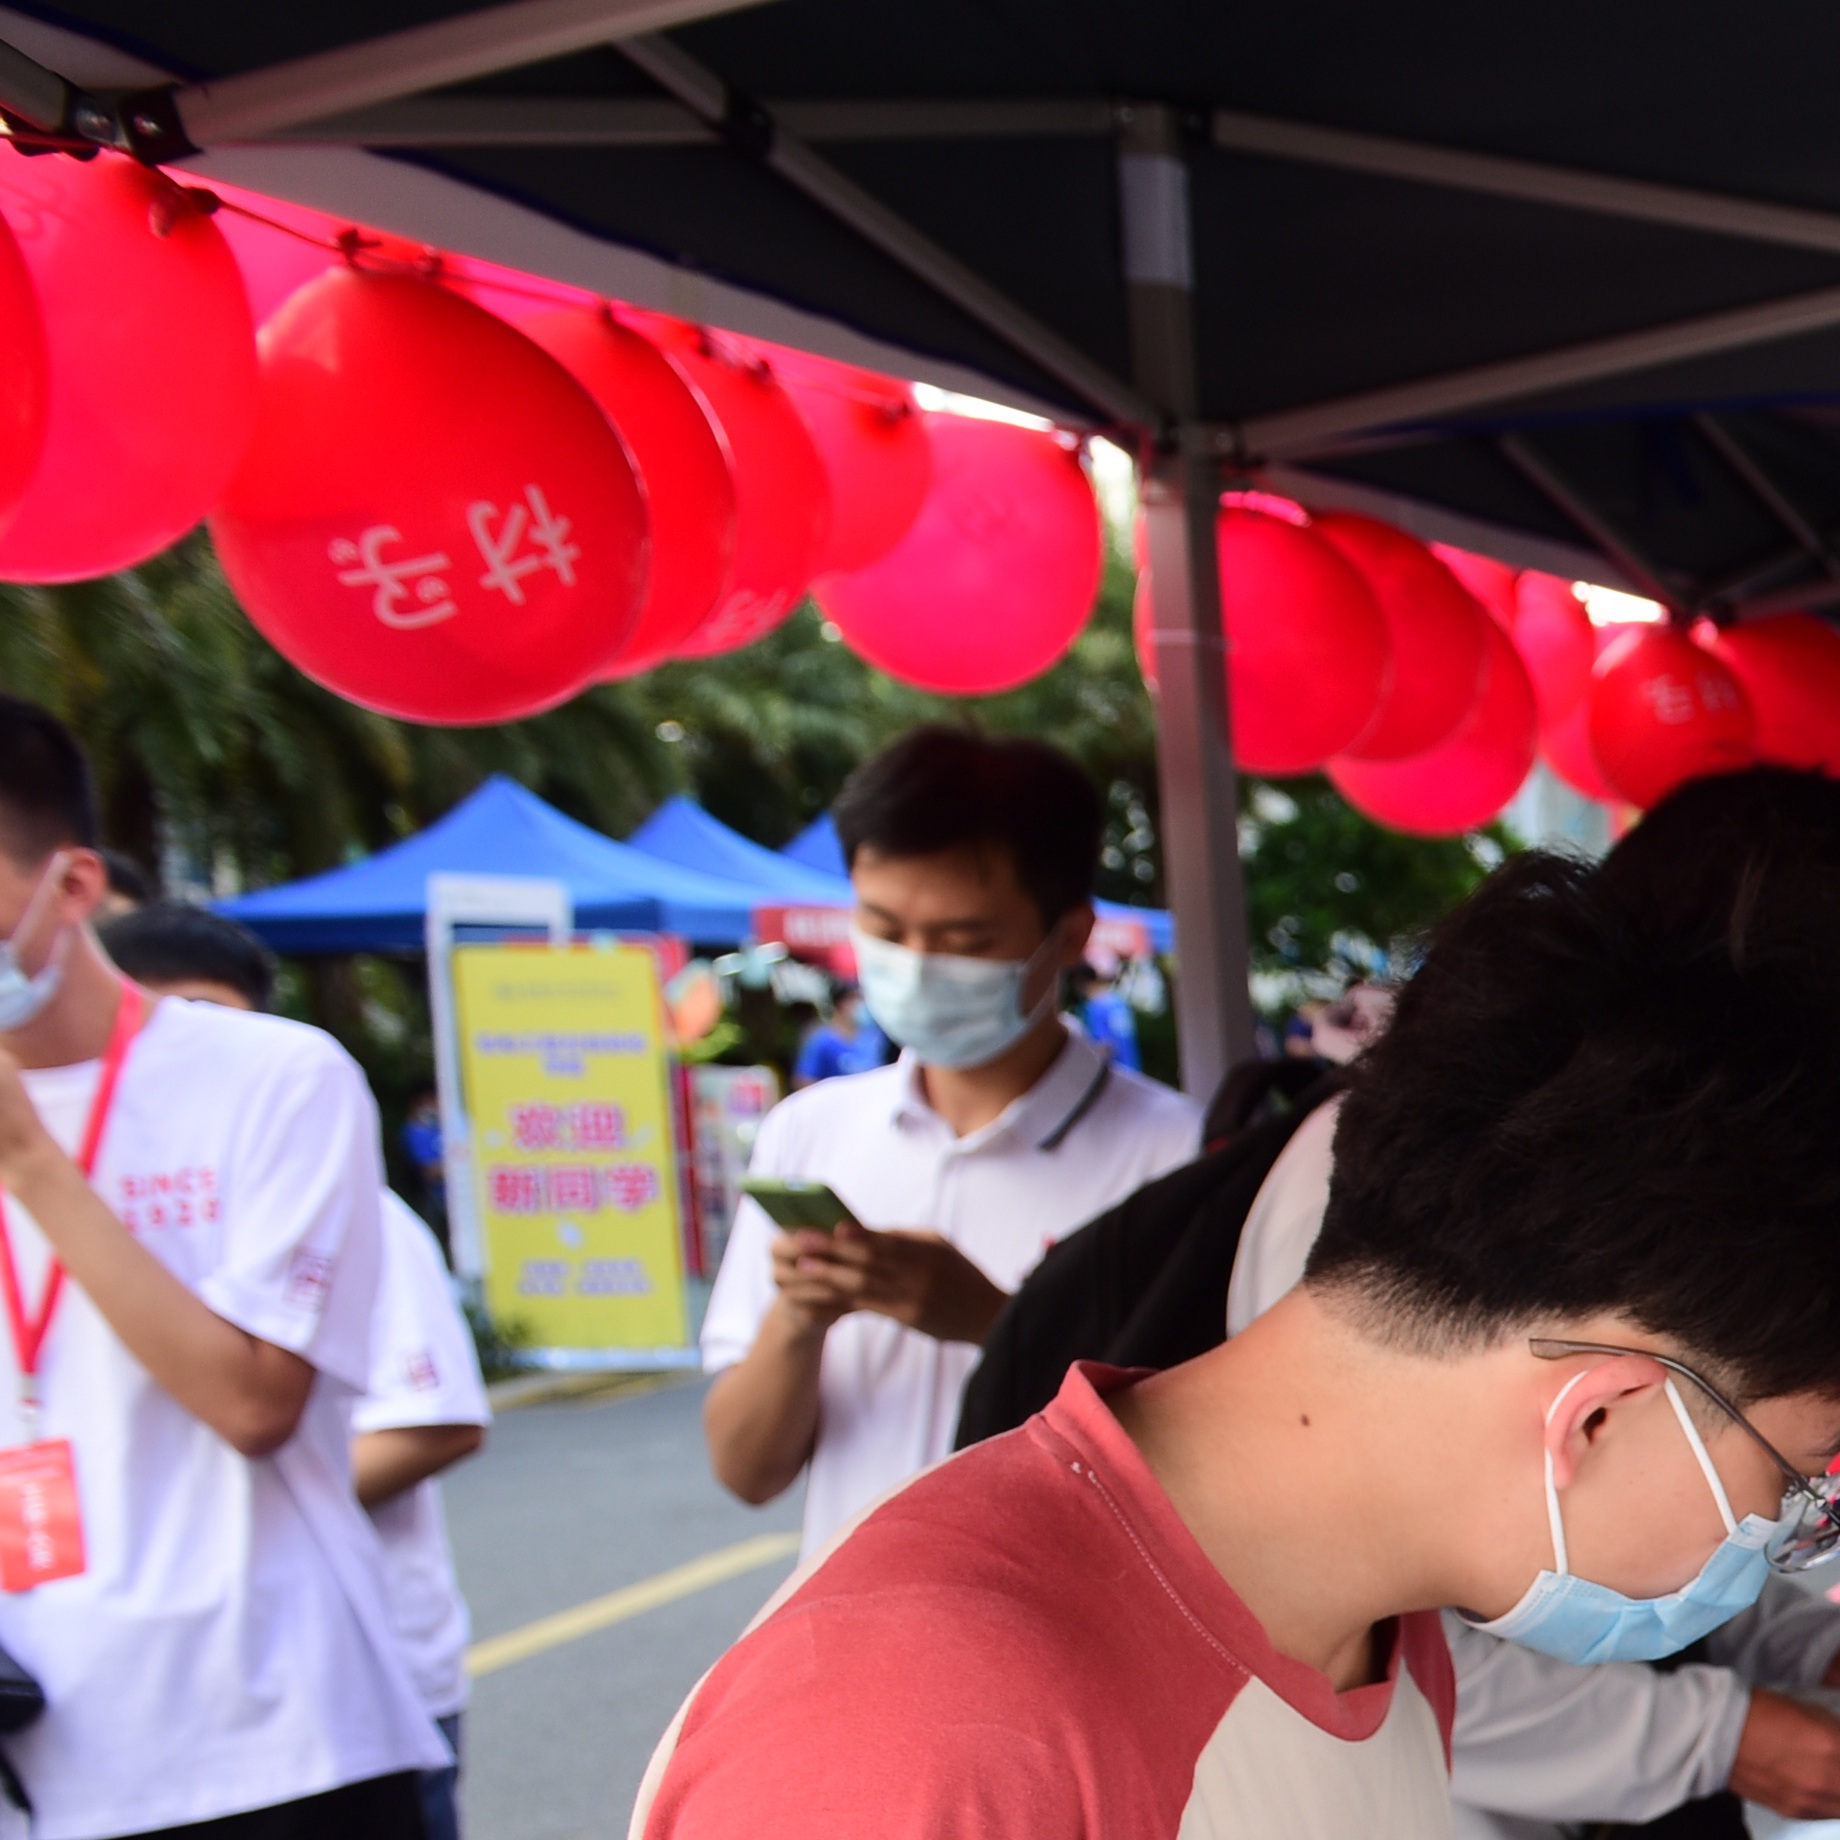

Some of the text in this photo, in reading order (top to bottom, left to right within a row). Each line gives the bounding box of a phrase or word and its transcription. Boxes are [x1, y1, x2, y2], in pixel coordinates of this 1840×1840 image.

[510, 1104, 624, 1151] 欢迎
[118, 1167, 218, 1199] SINCE
[489, 1165, 657, 1214] 新同学
